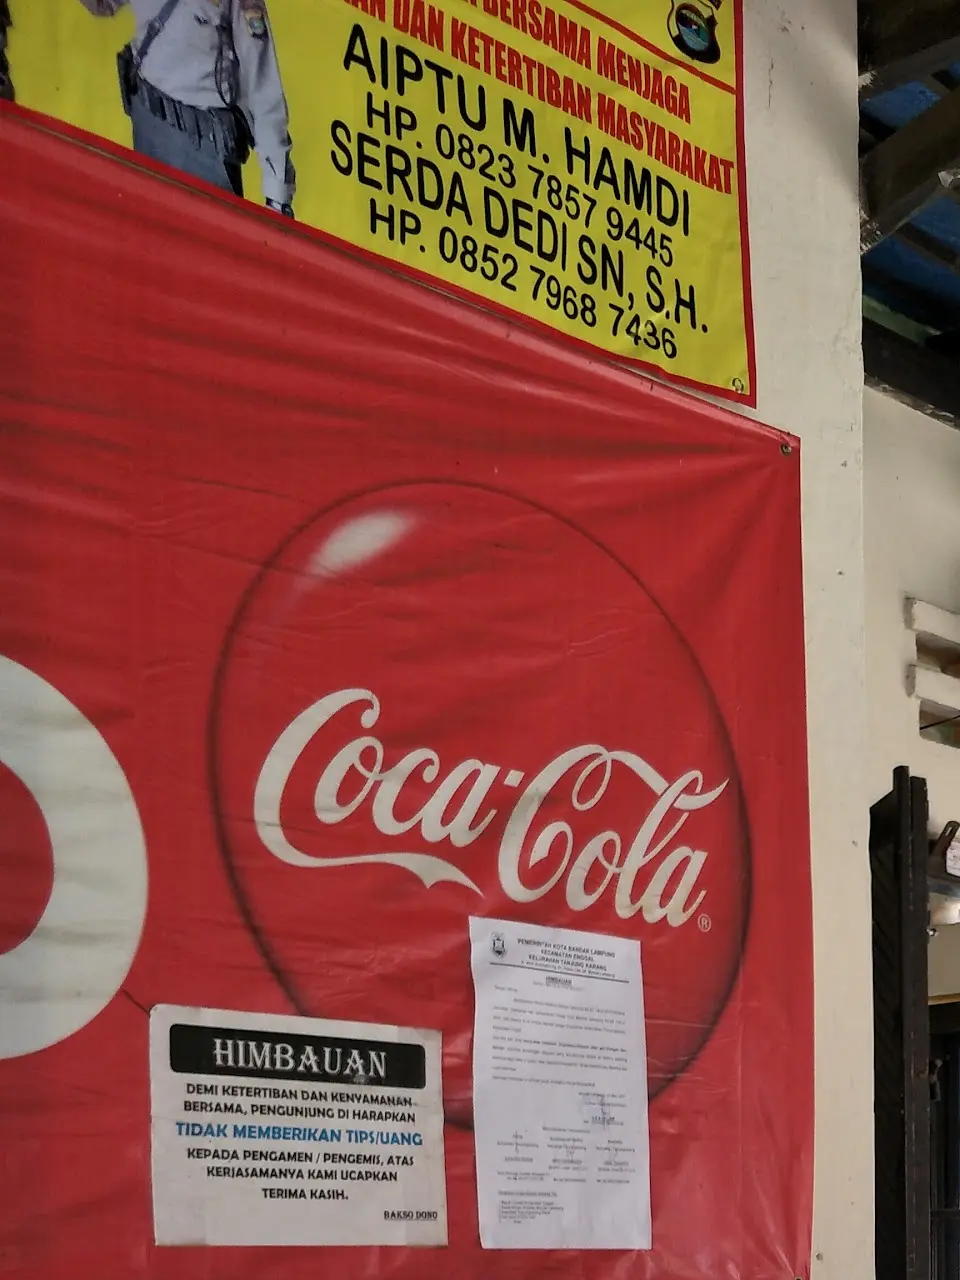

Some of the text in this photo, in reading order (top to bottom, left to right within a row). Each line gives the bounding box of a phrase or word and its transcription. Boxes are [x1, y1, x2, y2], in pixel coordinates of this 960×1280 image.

[597, 35, 691, 125] MENJAGA
[393, 0, 735, 195] DAN KETERTIBAN MASYARAKAT
[343, 23, 690, 237] AIPTU M. HAMDI
[366, 91, 674, 268] HP. 0823 7857 9445
[330, 119, 708, 334] SERDA DEDI SN, S.H.
[369, 197, 678, 360] HP. 0852 7968 7436
[212, 1037, 387, 1079] HIMBAUAN
[186, 1083, 413, 1107] DEMI KETERTIBAN DAN KENYAMANAN
[184, 1101, 416, 1124] BERSAMA, PENGUNJUNG DI HARAPKAN
[175, 1121, 423, 1146] TIDAK MEMBERIKAN TIPS/UANG
[187, 1148, 240, 1162] KEPADA
[243, 1149, 313, 1164] PENGAMEN
[323, 1152, 385, 1167] PENGEMIS,
[386, 1155, 415, 1167] ATAS
[206, 1166, 398, 1182] KERJASAMANYA KAMI UCAPKAN
[261, 1187, 349, 1201] TERIMA KASIH.
[383, 1210, 414, 1220] BAKSO
